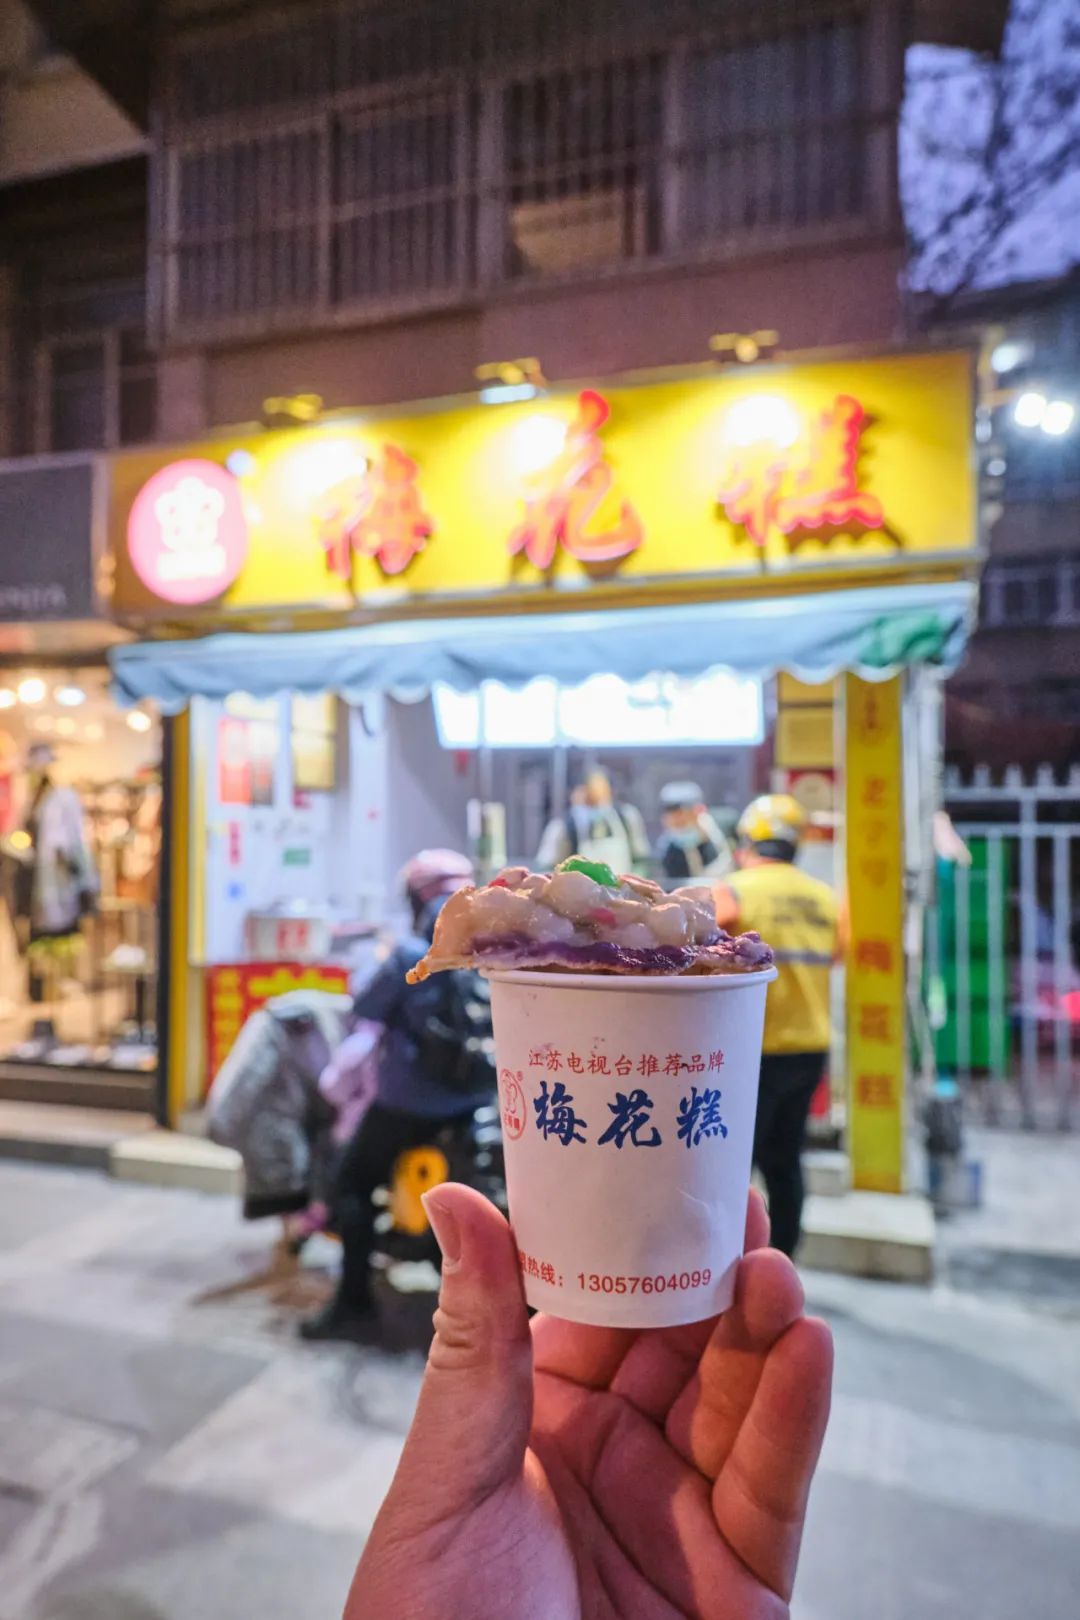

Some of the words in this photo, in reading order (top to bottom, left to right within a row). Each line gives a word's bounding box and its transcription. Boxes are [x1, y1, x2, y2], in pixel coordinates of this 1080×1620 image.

[528, 1050, 725, 1077] 江苏电视台推荐品牌
[533, 1080, 728, 1149] 梅花糕
[577, 1268, 712, 1294] 13057604099
